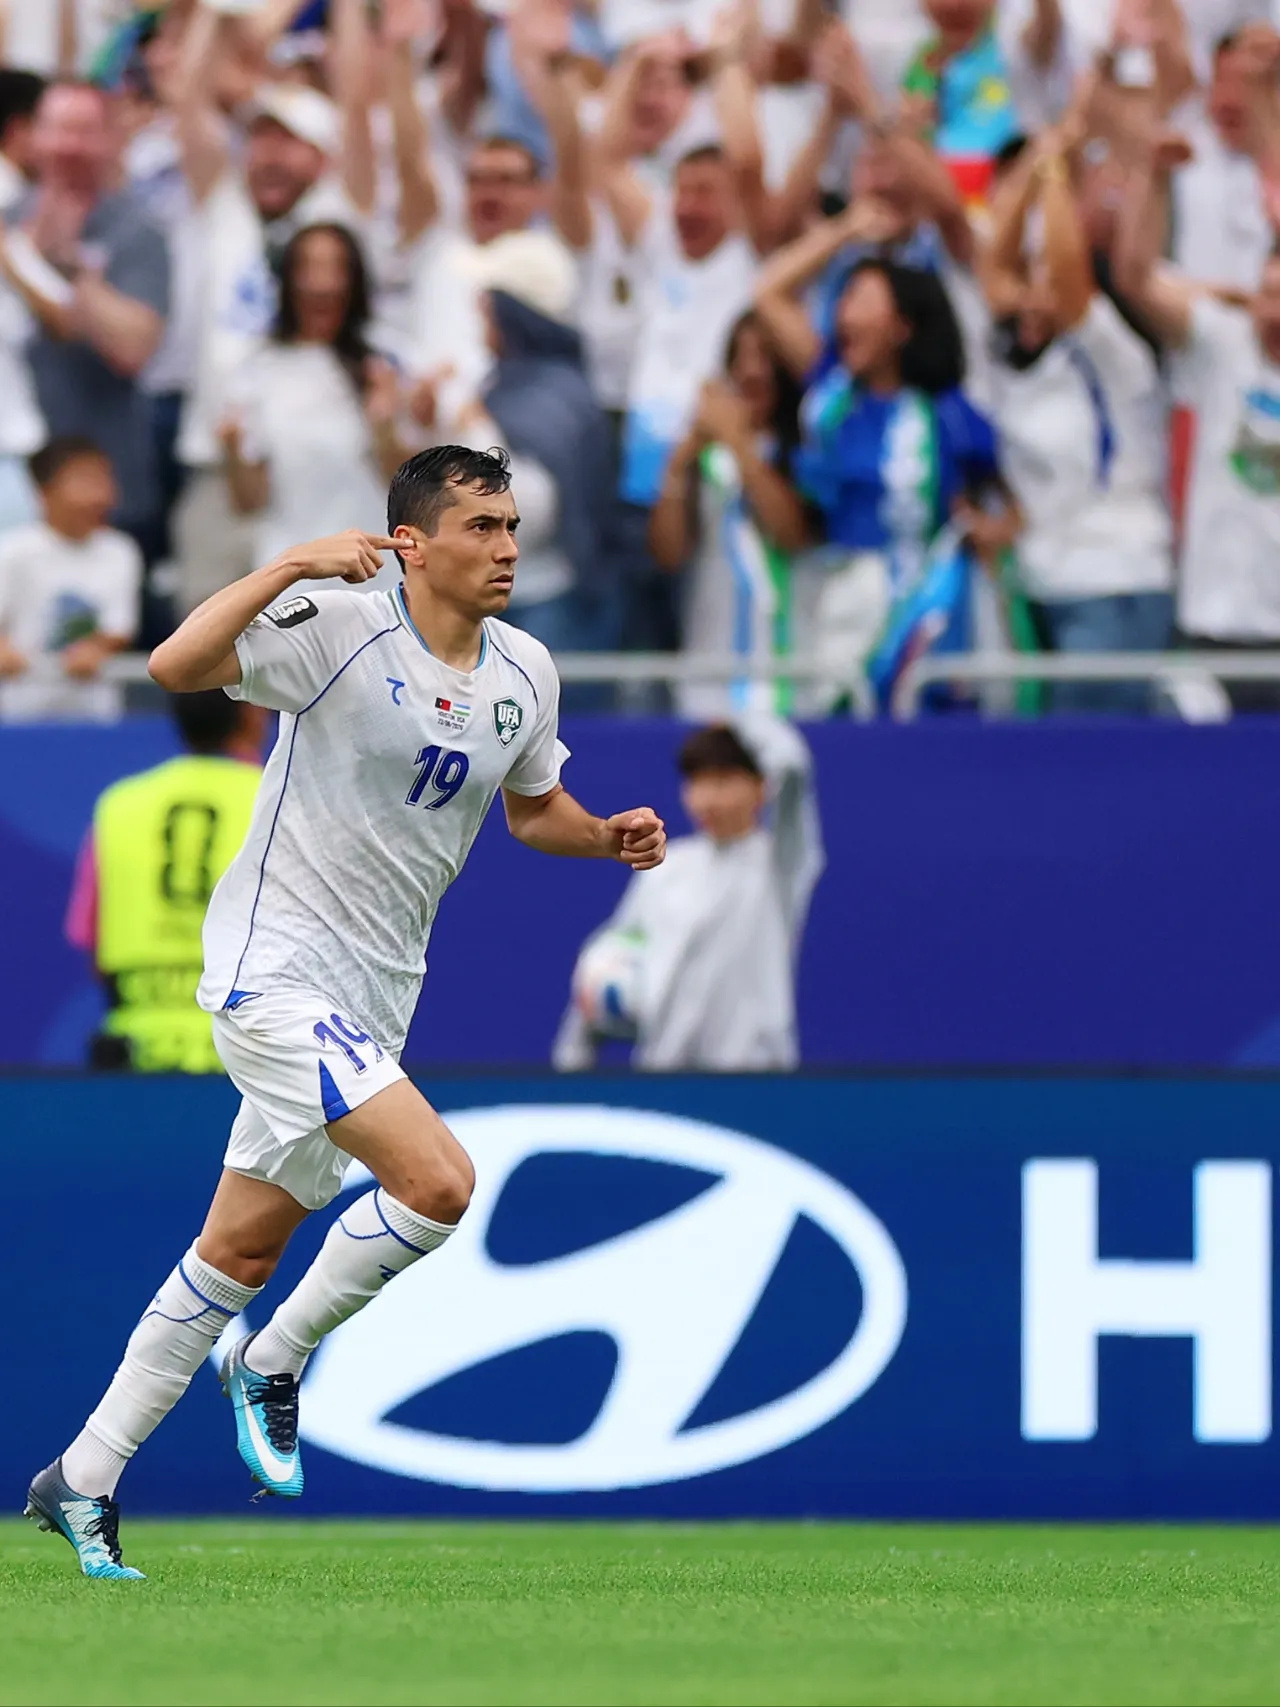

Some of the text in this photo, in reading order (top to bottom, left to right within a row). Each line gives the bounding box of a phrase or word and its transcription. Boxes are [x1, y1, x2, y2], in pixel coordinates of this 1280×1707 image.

[498, 706, 519, 726] UFA
[405, 745, 469, 811] 19
[313, 1013, 384, 1075] 19
[1021, 1156, 1272, 1444] H
